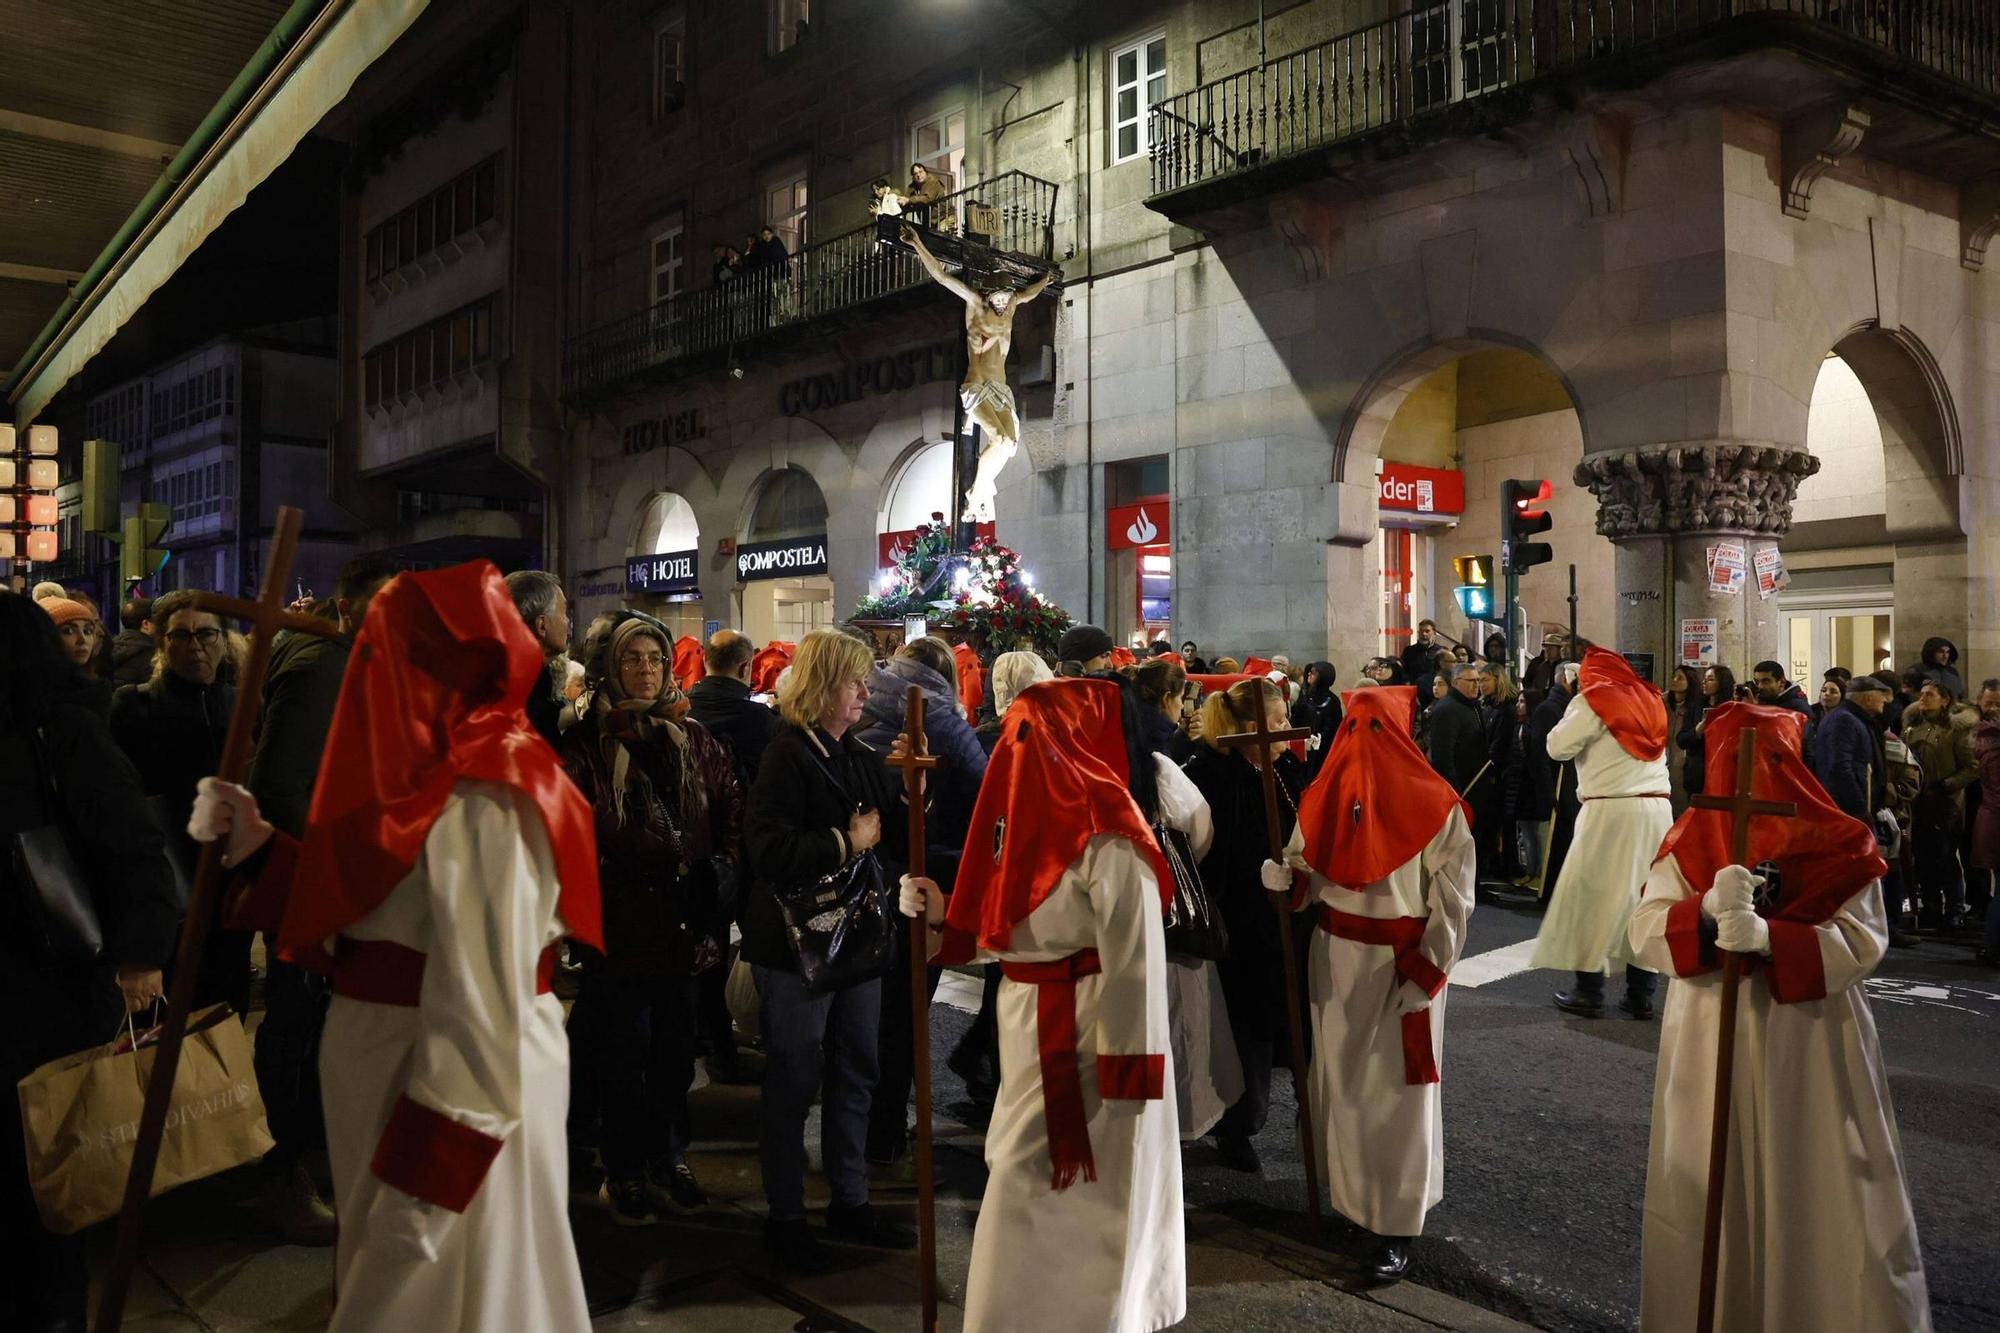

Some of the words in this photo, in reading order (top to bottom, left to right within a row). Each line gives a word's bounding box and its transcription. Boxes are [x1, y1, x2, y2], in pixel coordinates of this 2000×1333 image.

[975, 209, 999, 232] INRI
[623, 408, 706, 456] HOTEL
[652, 557, 694, 581] HOTEL
[738, 545, 826, 576] COMPOSTELA
